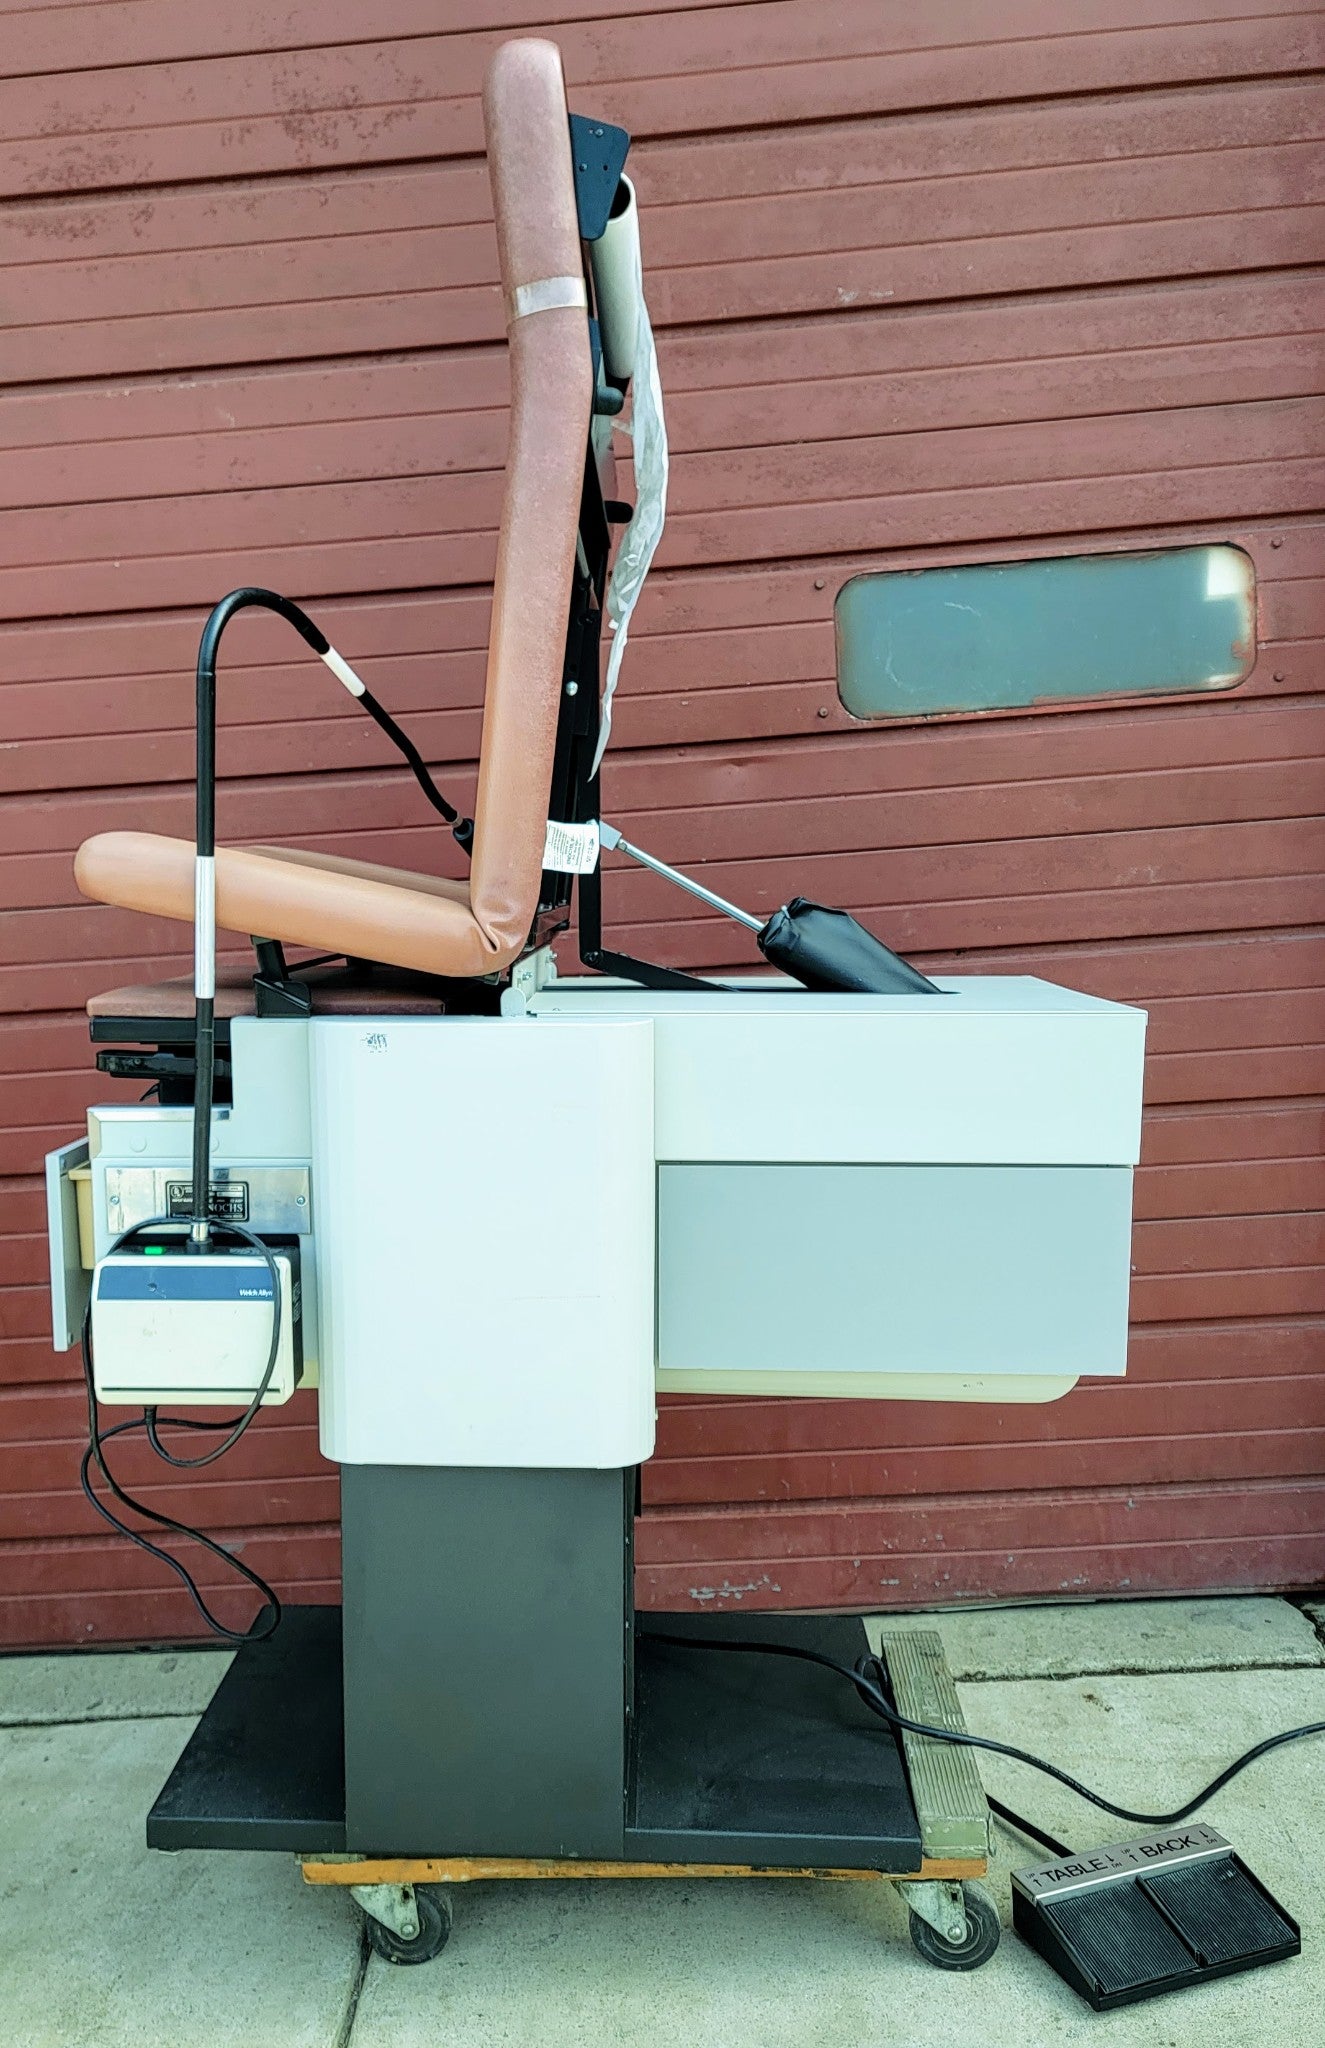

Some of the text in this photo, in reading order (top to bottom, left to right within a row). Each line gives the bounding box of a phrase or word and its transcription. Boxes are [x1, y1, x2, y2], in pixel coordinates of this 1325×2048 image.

[208, 1203, 243, 1213] NOCHS
[239, 1289, 258, 1297] Welch
[1139, 1835, 1200, 1858] BACK
[1040, 1858, 1108, 1882] TABLE
